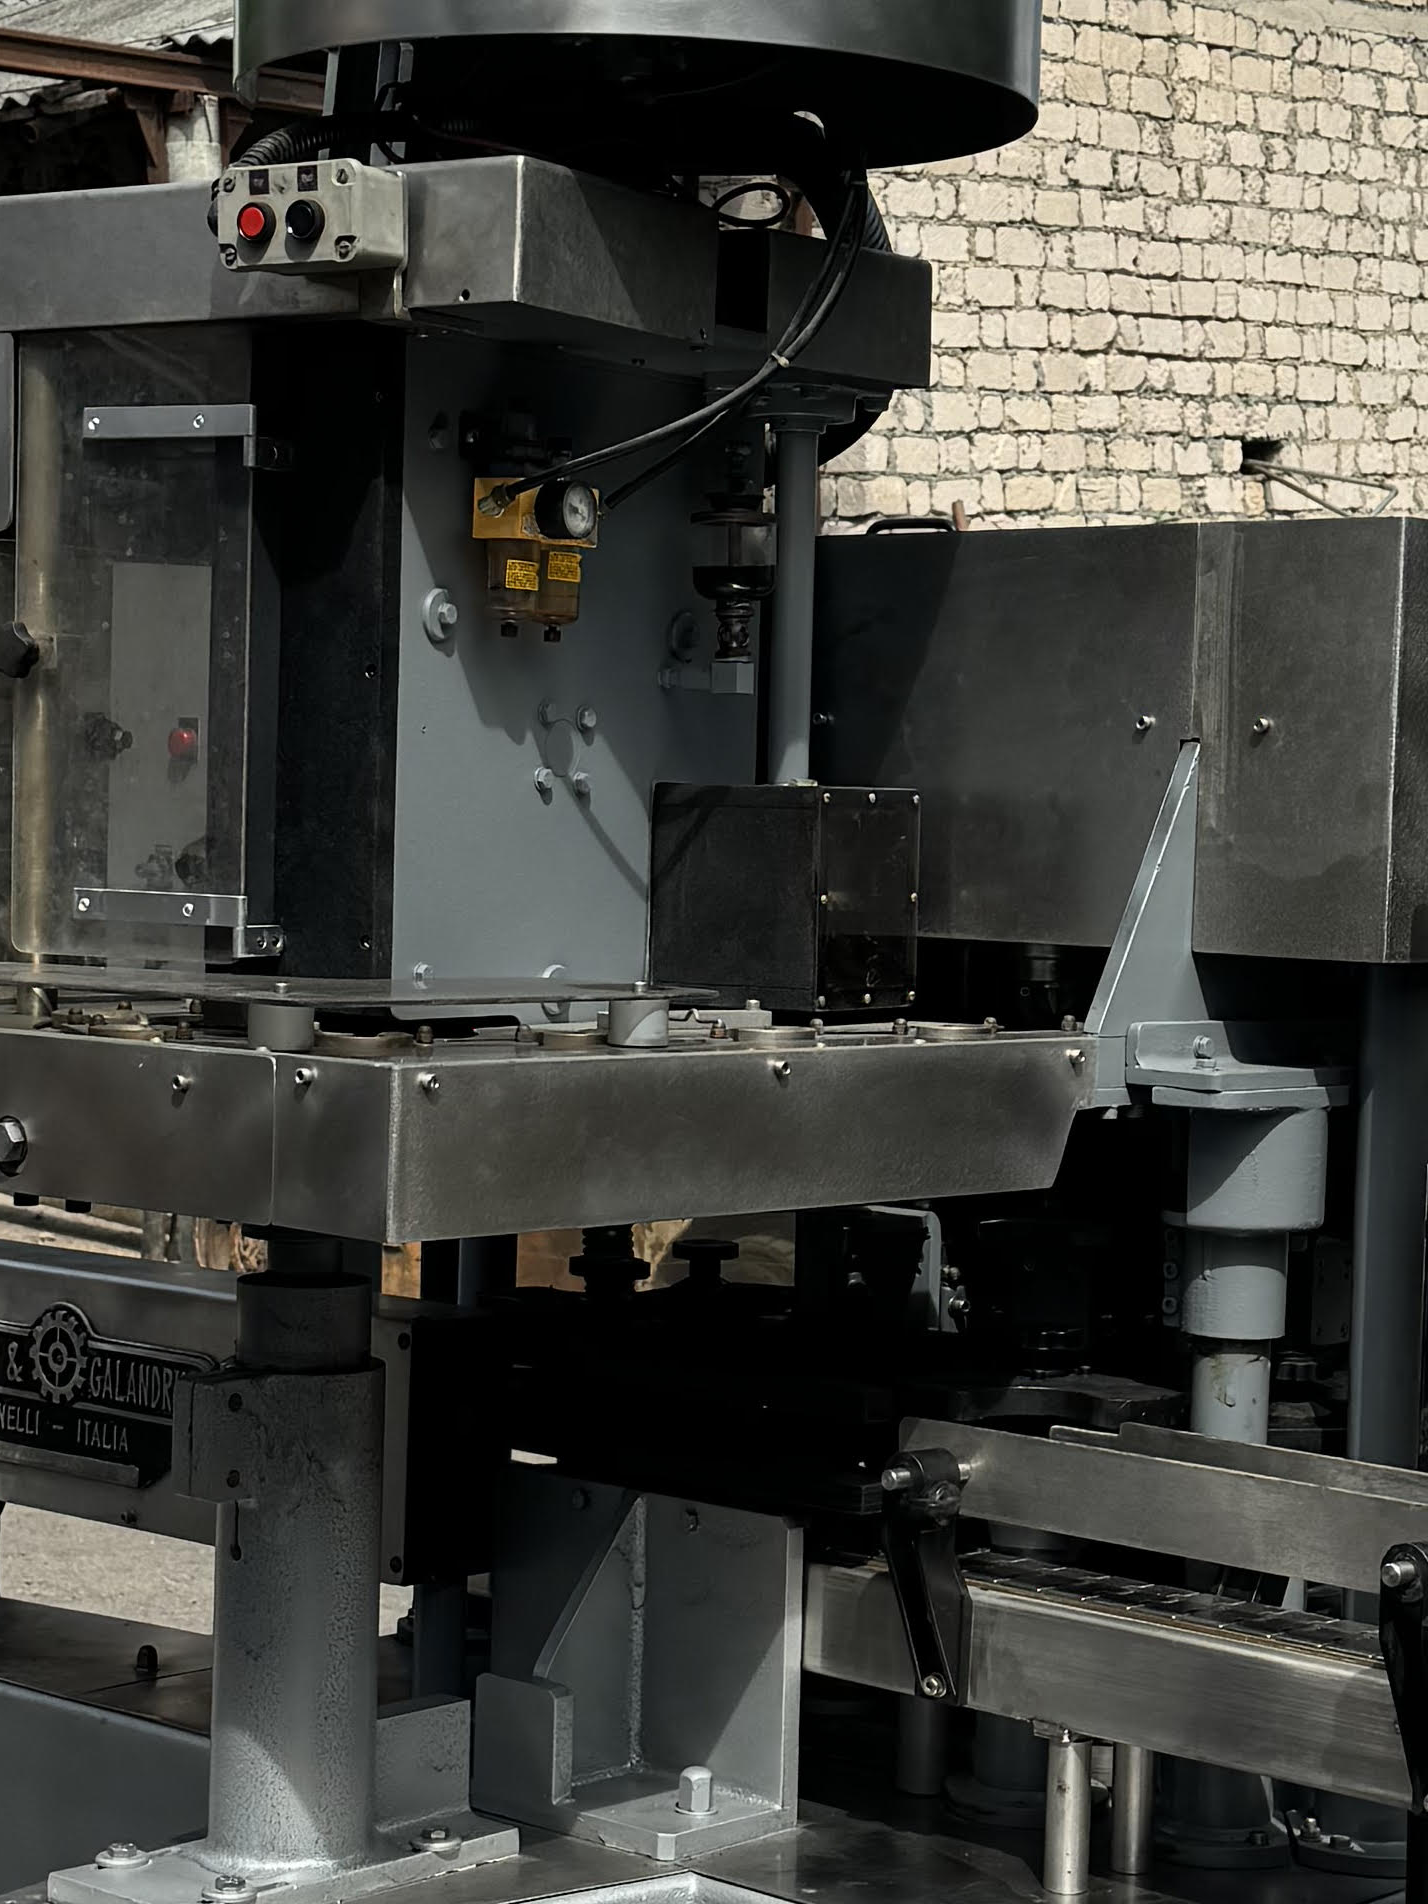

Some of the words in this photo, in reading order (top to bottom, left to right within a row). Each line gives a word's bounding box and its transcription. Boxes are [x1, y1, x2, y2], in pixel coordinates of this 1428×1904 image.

[6, 1341, 24, 1382] &
[89, 1356, 185, 1414] GALANDR
[76, 1418, 129, 1453] ITALIA
